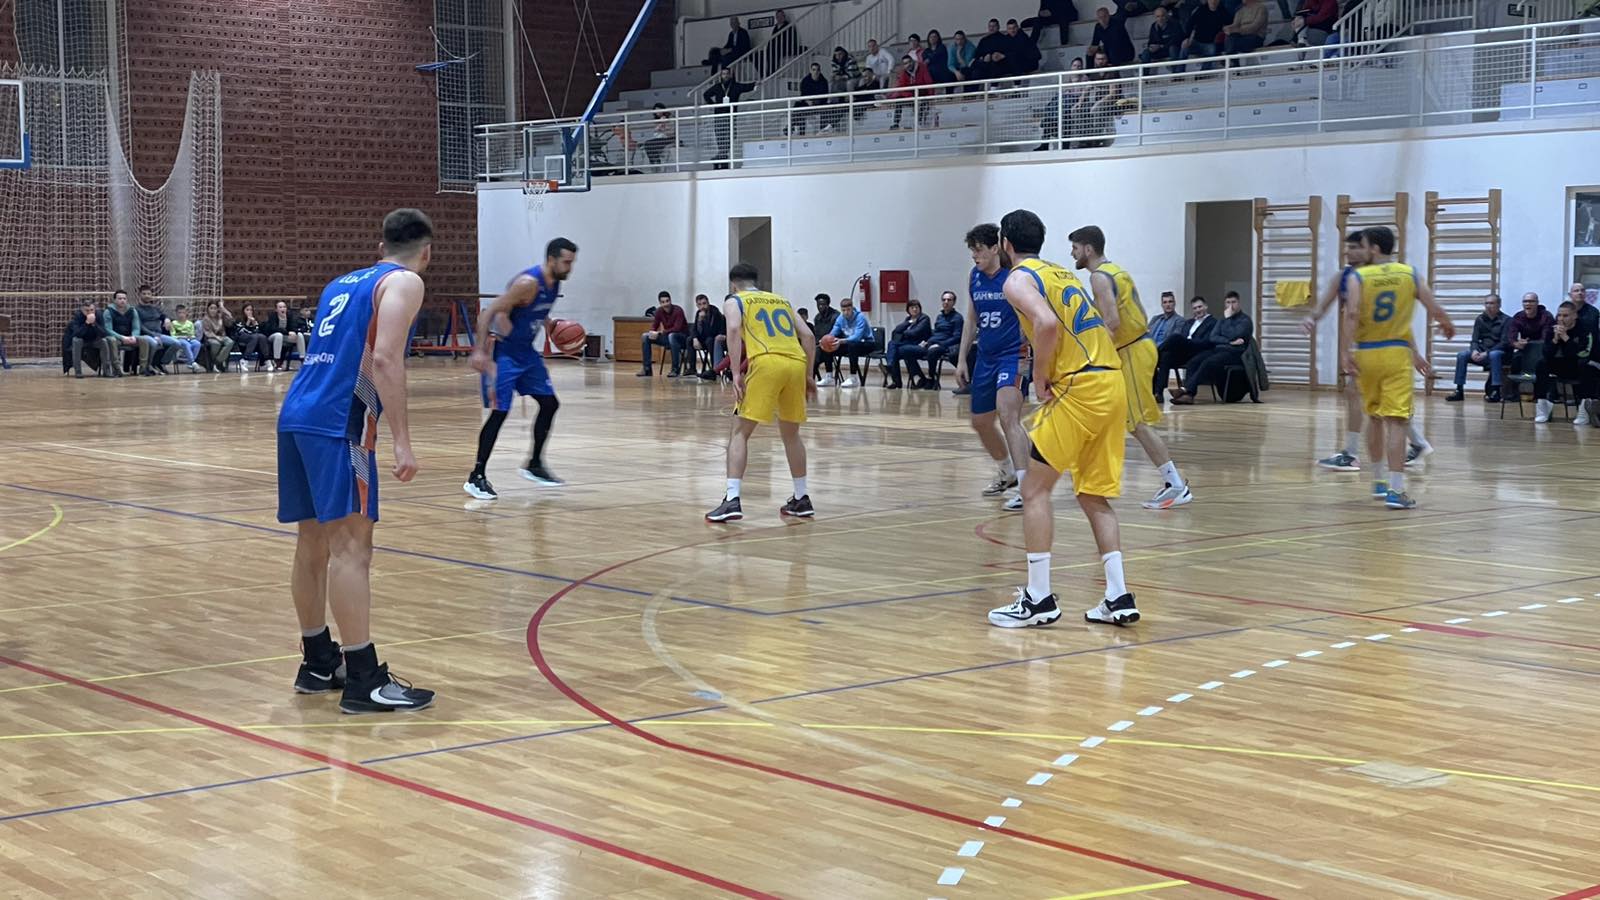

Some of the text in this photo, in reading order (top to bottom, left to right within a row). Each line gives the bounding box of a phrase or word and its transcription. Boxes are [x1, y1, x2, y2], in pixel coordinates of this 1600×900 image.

[318, 292, 350, 338] 2
[980, 311, 1002, 328] 35
[1373, 290, 1396, 322] 8
[755, 307, 794, 337] 10
